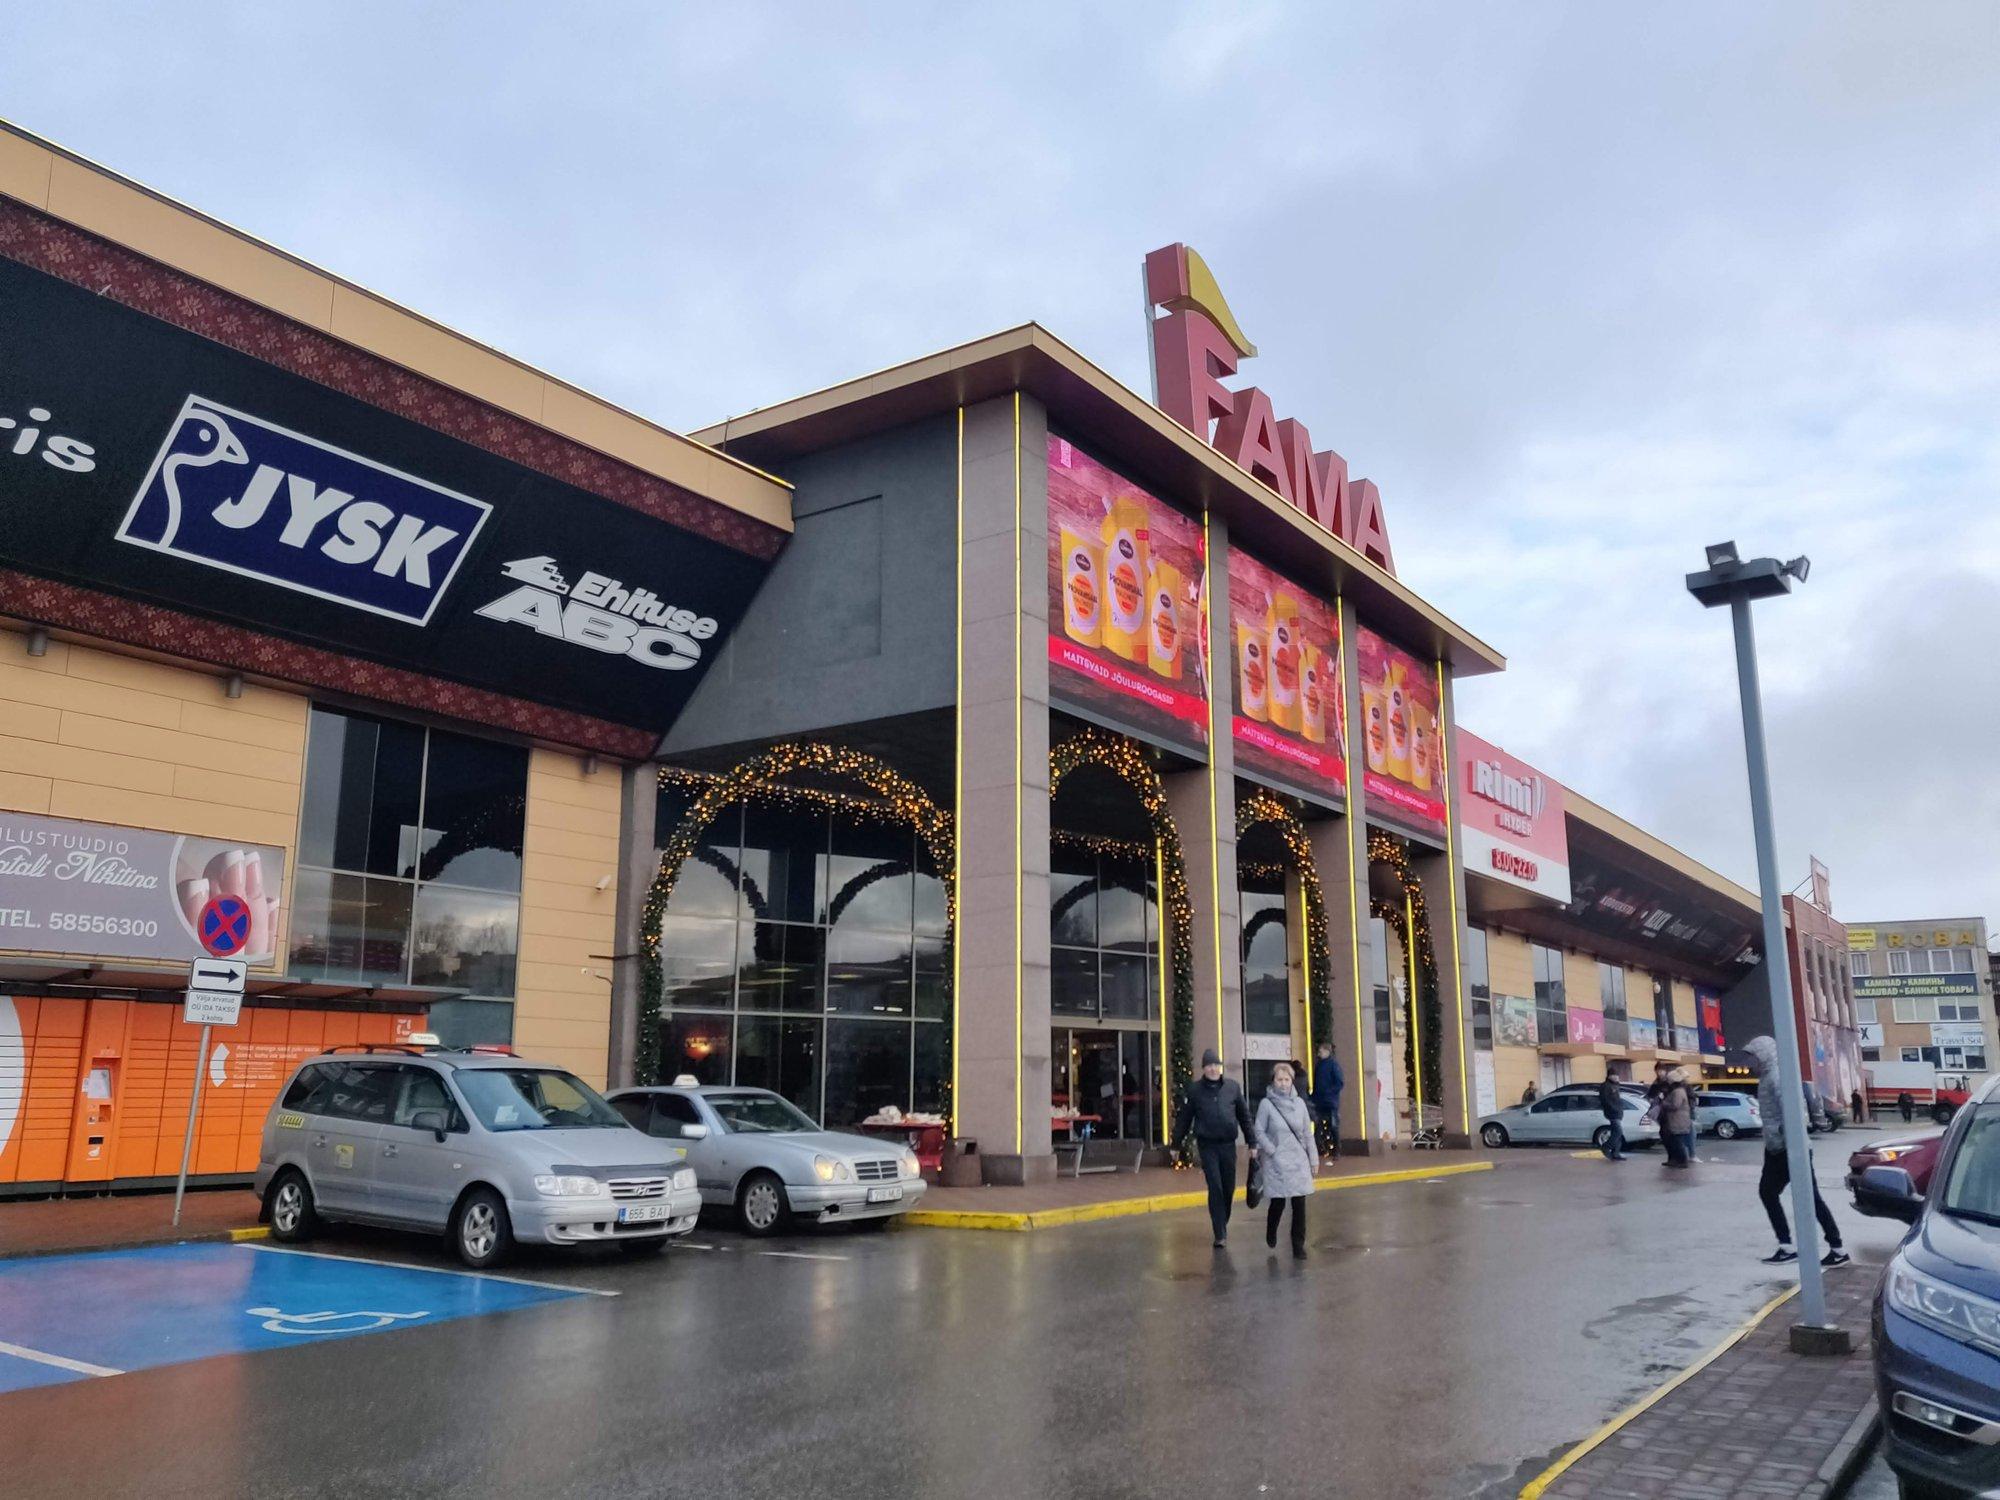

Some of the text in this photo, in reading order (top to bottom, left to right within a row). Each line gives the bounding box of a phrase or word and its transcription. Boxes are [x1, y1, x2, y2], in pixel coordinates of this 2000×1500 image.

[1143, 242, 1397, 580] FAMA
[211, 463, 460, 589] JYSK
[473, 585, 702, 671] ABC
[569, 570, 718, 640] Ehituse
[1063, 649, 1174, 705] MAITSVAID JÕULUROOGASID
[1475, 760, 1532, 817] Rimi
[1503, 813, 1533, 837] HYPER
[55, 851, 158, 889] Nikitina
[0, 908, 158, 938] TEL. 58556300
[1887, 930, 1975, 949] ROBA
